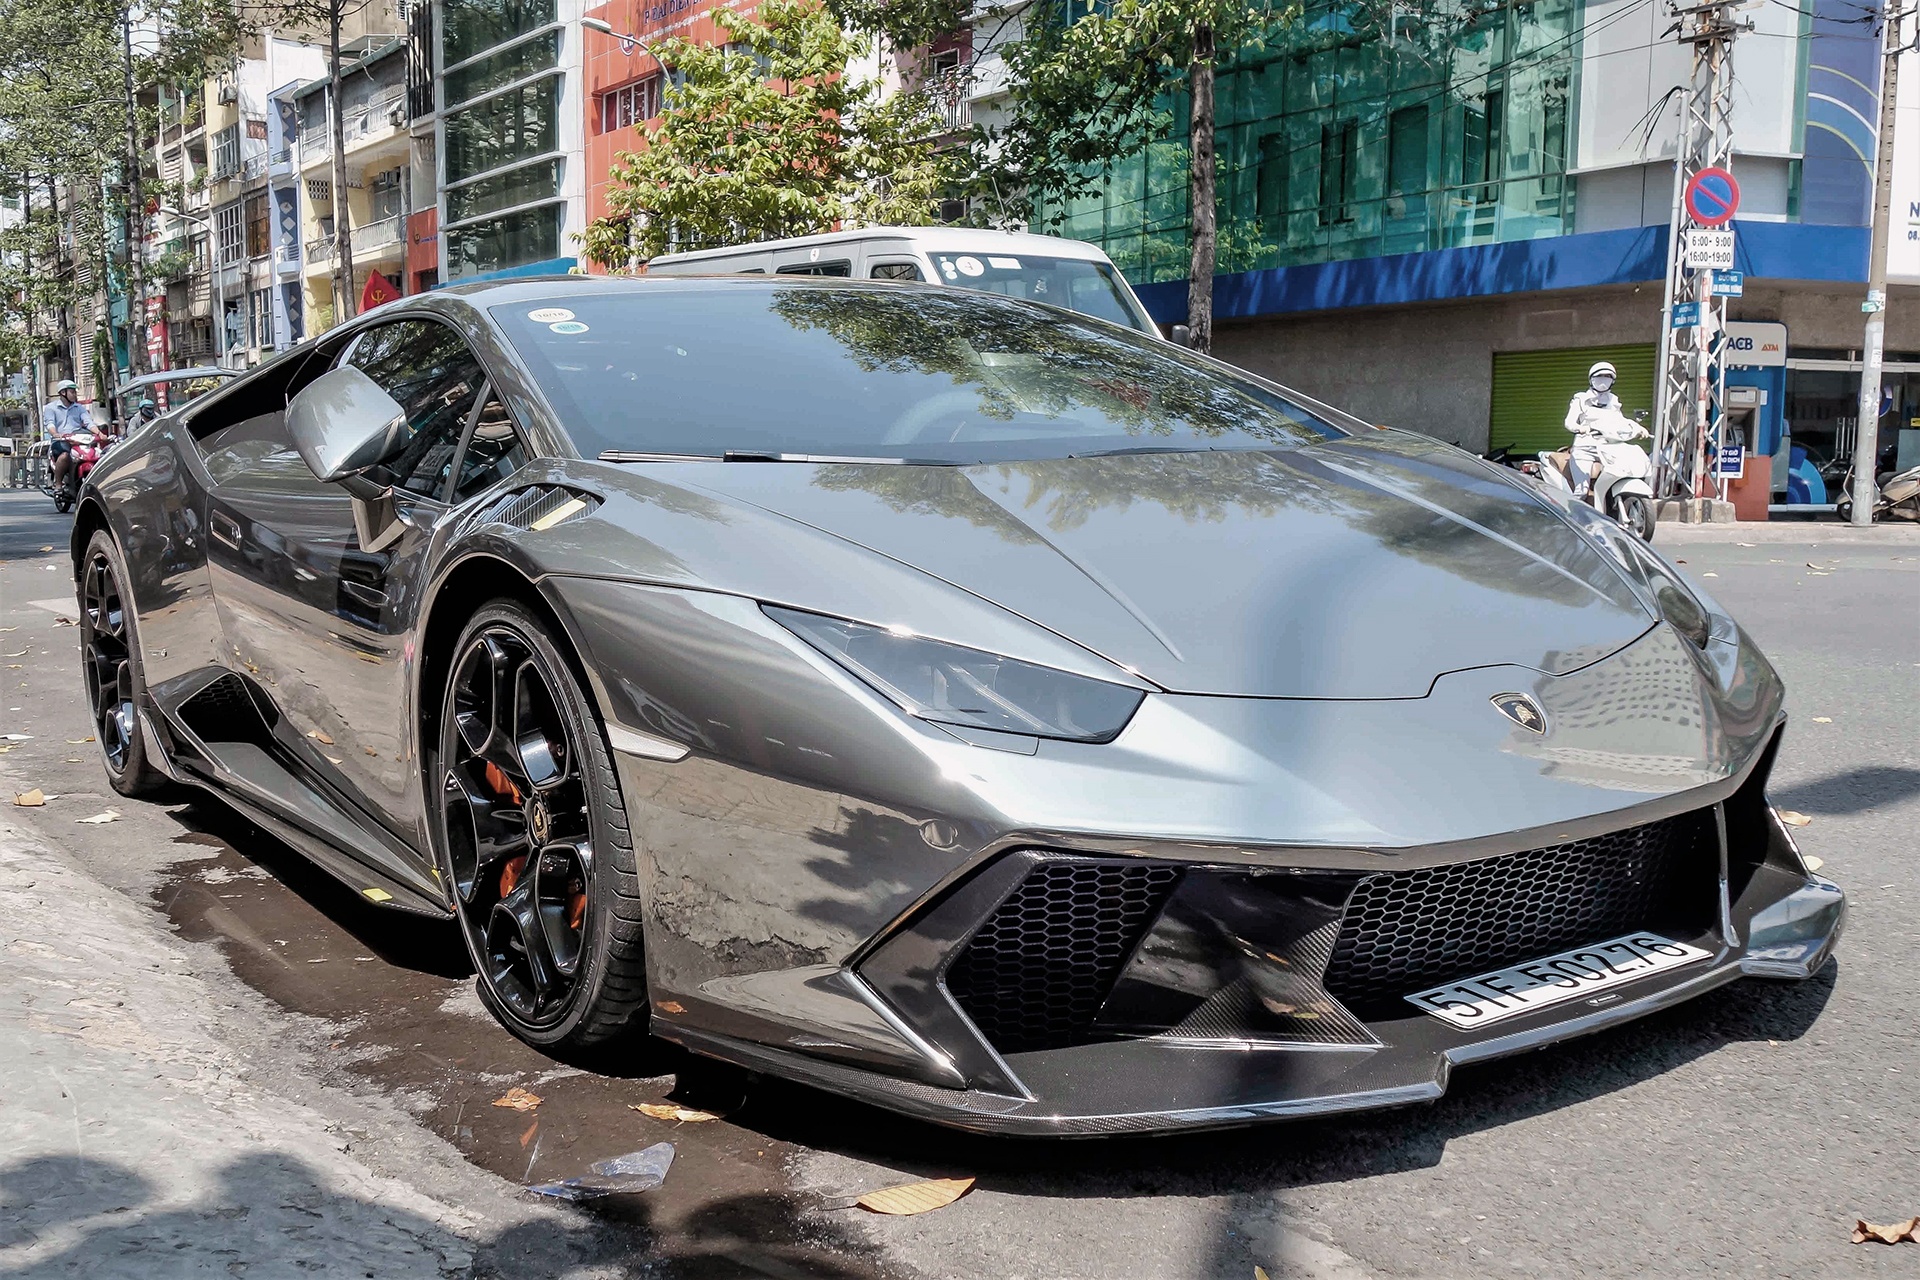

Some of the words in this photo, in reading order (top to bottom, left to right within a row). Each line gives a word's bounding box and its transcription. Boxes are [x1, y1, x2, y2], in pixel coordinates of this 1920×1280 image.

[1726, 337, 1753, 350] ACB
[1761, 343, 1779, 352] ATM
[1418, 937, 1688, 1018] 51F-502.76
